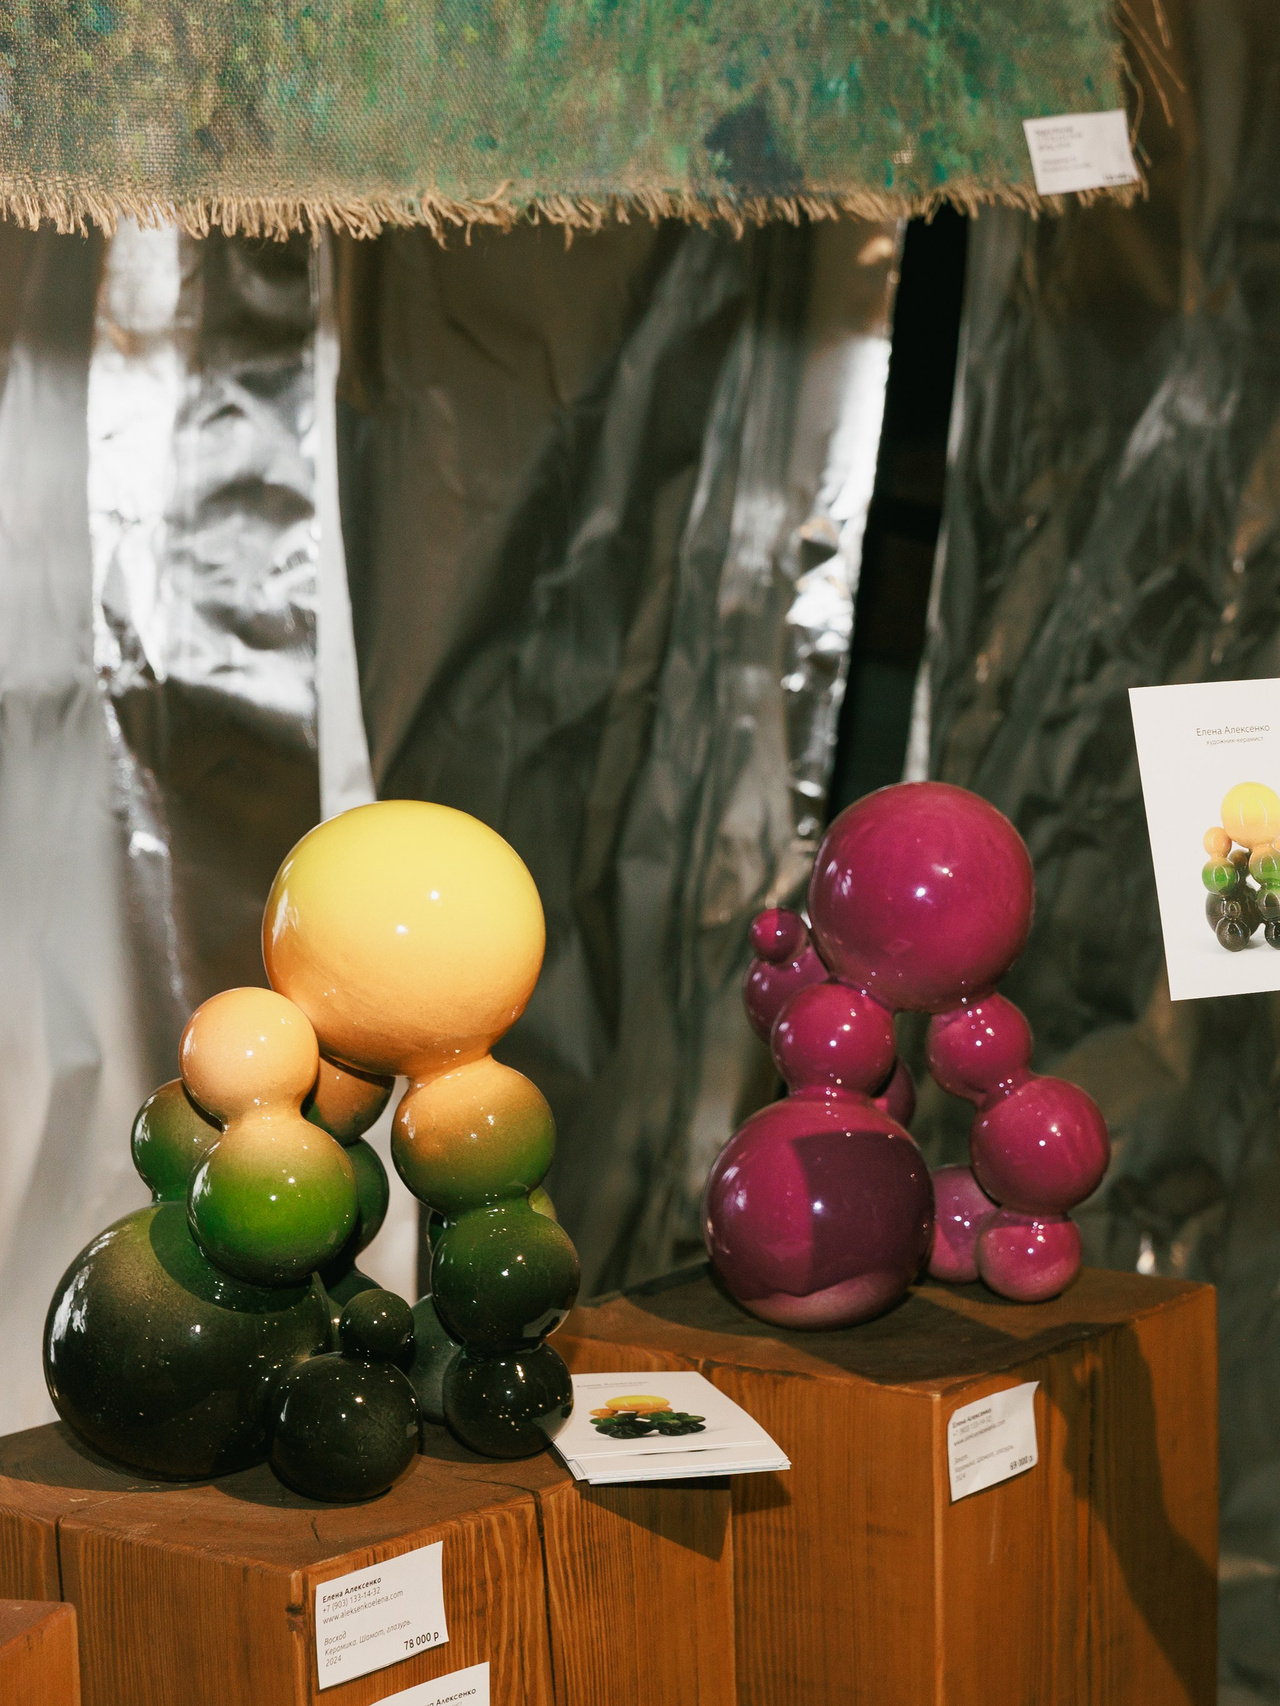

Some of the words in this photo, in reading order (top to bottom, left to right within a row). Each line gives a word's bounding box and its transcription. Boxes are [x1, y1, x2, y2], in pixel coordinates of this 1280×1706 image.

[1196, 727, 1222, 737] Елена
[1224, 724, 1270, 734] Алексенко
[322, 1591, 343, 1604] Елена
[344, 1577, 382, 1595] Алексенко
[323, 1604, 331, 1613] +7
[332, 1598, 349, 1612] (903)
[350, 1586, 381, 1604] 133-14-32
[322, 1590, 404, 1624] www.aleksenkoelena.com
[324, 1630, 347, 1646] Восход
[403, 1638, 414, 1651] 78
[416, 1632, 431, 1646] 000
[326, 1655, 342, 1667] 2024
[436, 1688, 477, 1706] Алексенко
